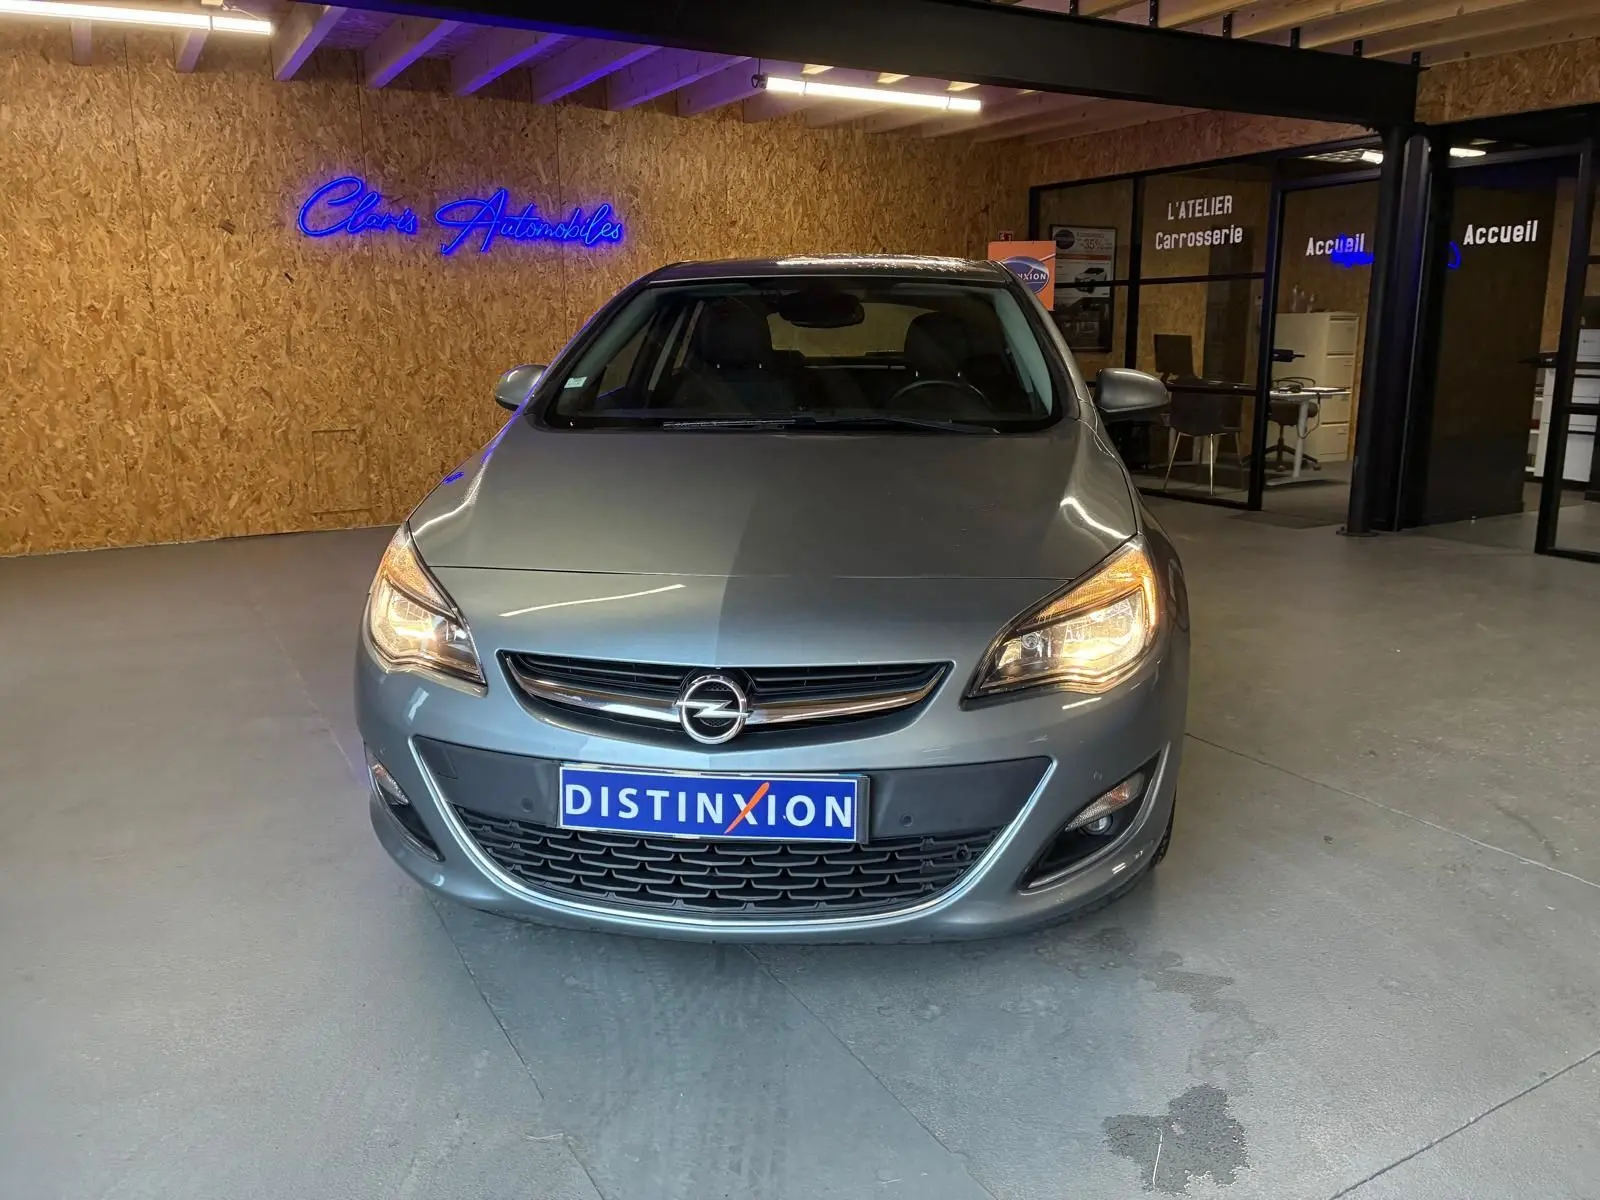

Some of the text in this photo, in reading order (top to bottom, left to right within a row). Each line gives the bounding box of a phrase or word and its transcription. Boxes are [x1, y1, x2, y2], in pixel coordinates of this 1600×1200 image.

[298, 176, 623, 255] Claris Automobiles
[1167, 194, 1233, 221] L'ATELIER
[1155, 224, 1243, 250] Carrosserie
[1305, 232, 1366, 257] Accueil
[1463, 219, 1539, 246] Accueil
[564, 781, 853, 835] DISTINXION
